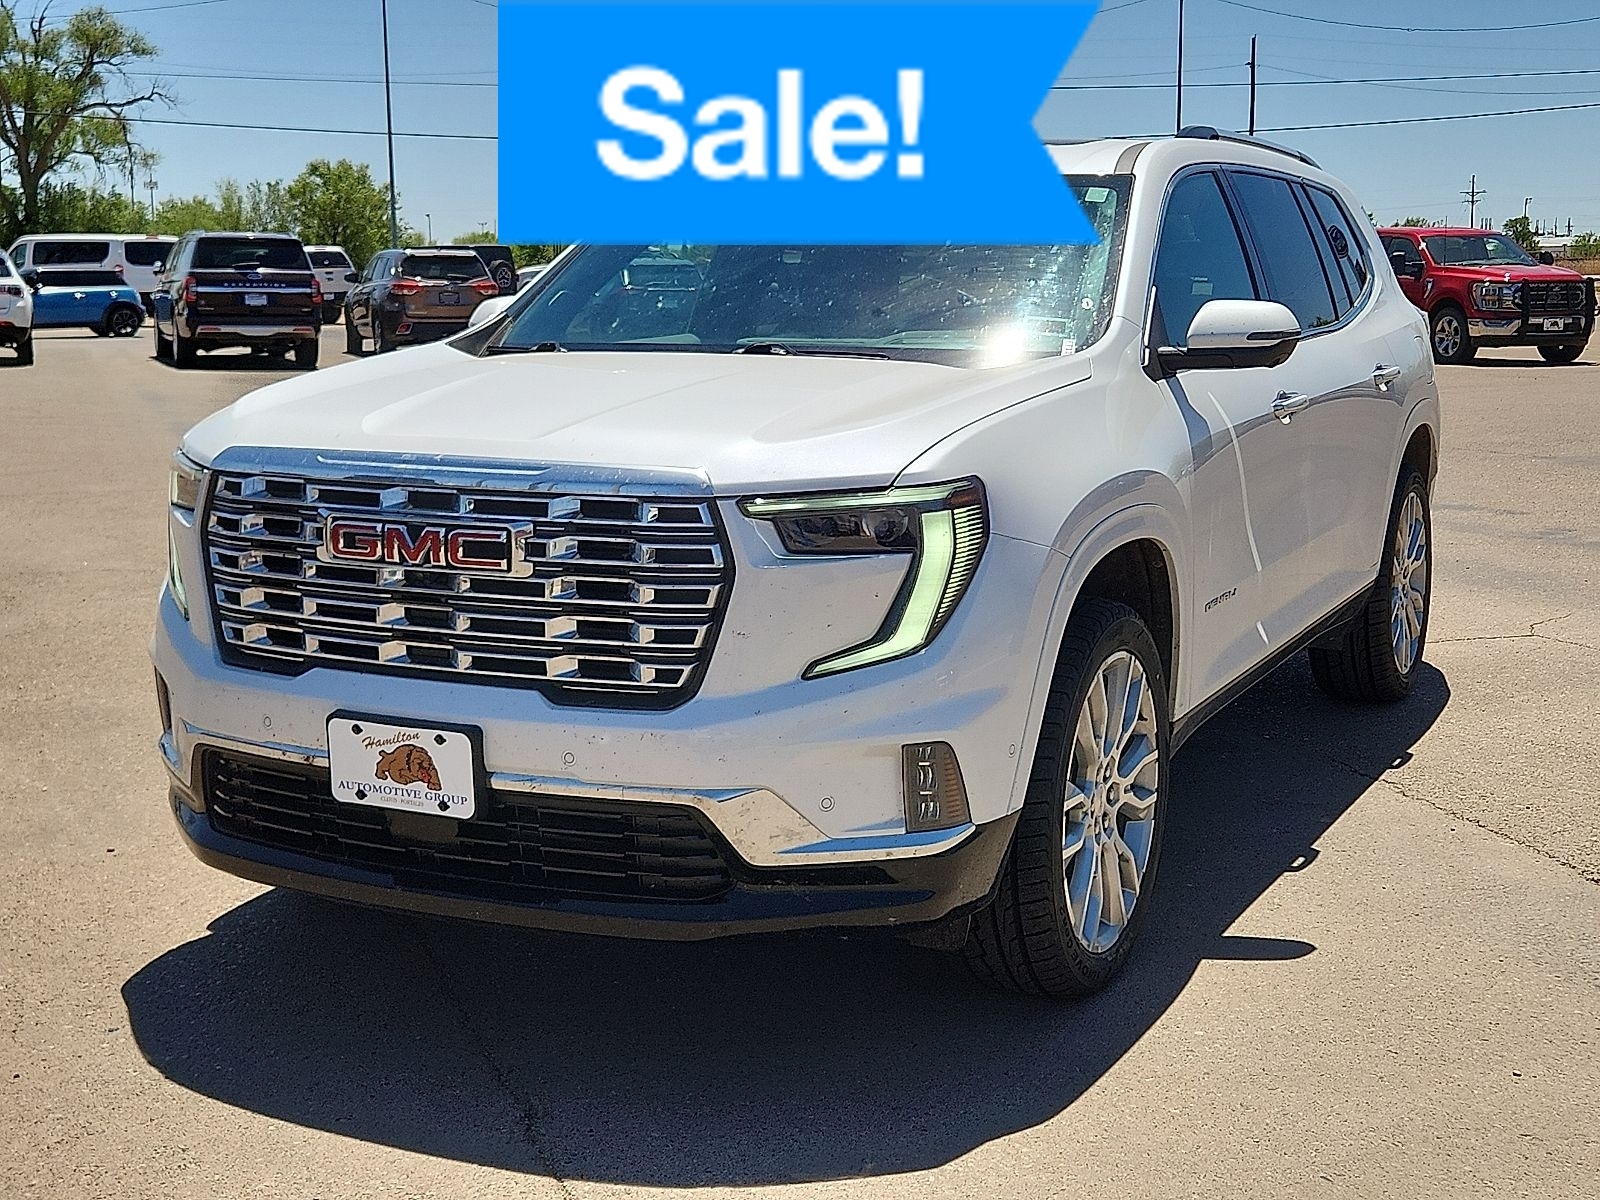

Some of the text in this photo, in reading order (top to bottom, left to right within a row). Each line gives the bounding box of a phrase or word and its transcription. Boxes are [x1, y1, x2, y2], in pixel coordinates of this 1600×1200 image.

[331, 521, 507, 569] GMC
[361, 731, 420, 749] Hamilton
[338, 780, 421, 799] AUTOMOTIVE
[424, 791, 468, 806] GROUP
